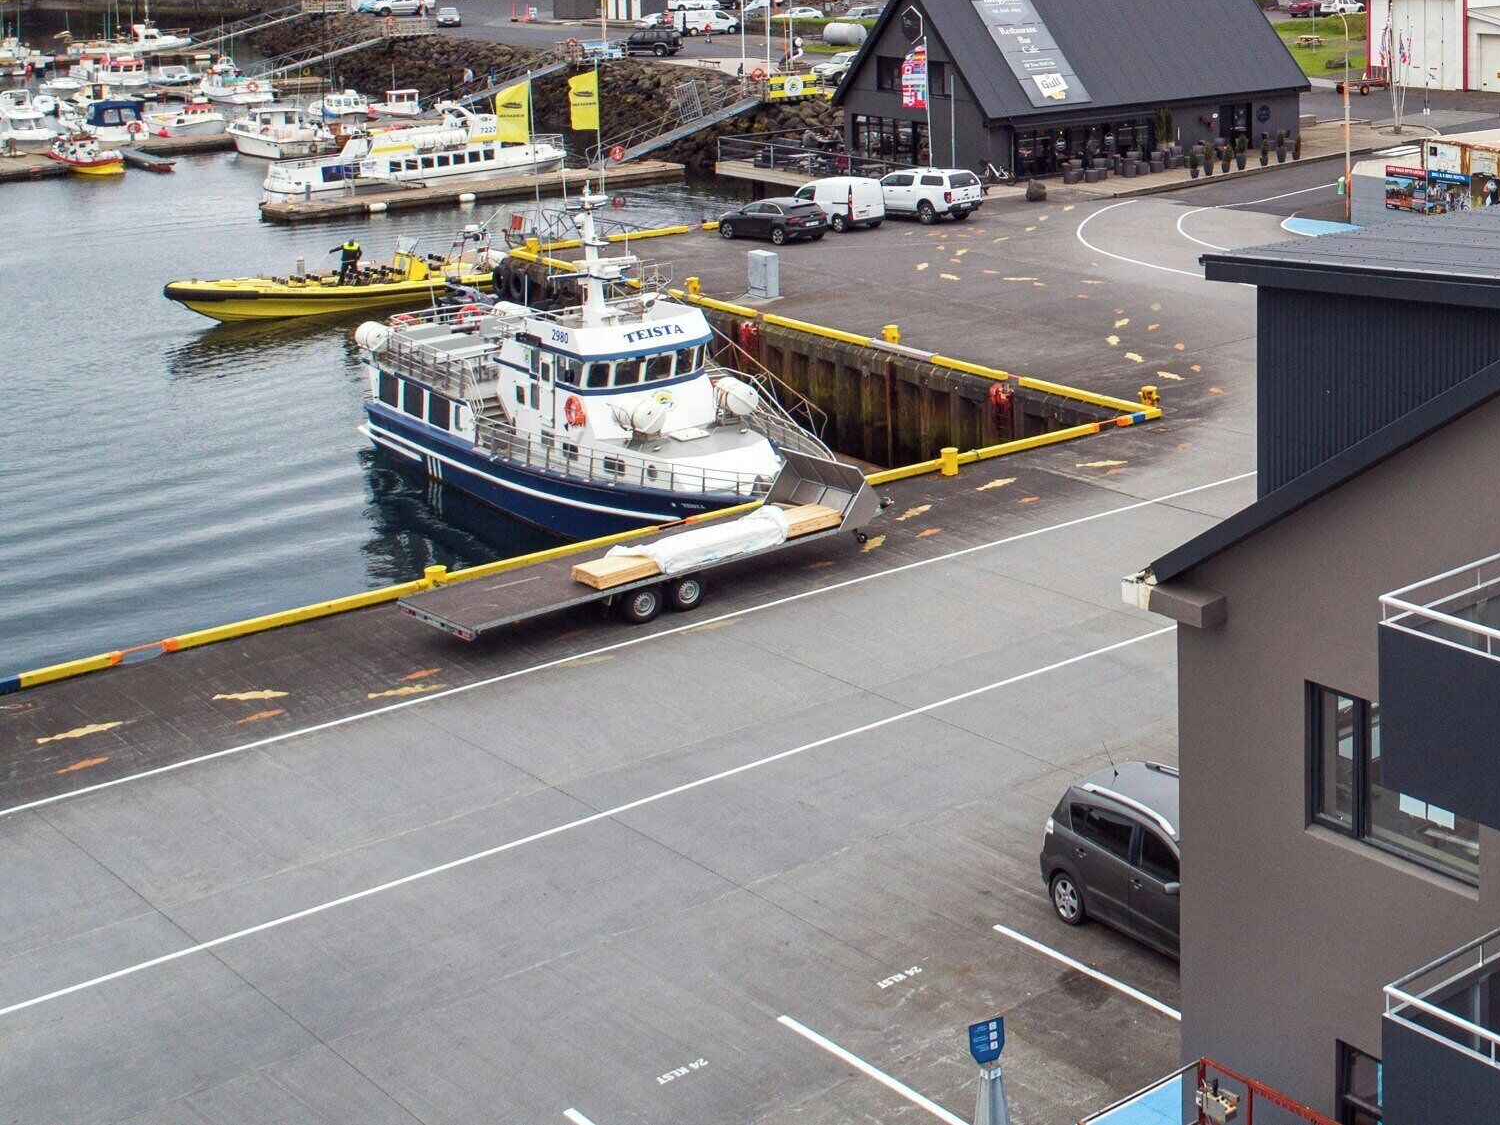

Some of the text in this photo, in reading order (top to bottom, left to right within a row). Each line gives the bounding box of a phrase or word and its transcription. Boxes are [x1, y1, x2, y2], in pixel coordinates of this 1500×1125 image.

[998, 27, 1038, 35] Restaurant
[1017, 36, 1031, 44] Bar
[1040, 77, 1063, 89] Gull
[551, 329, 569, 344] 2980
[623, 324, 685, 343] TEISTA
[656, 1066, 690, 1085] KLST
